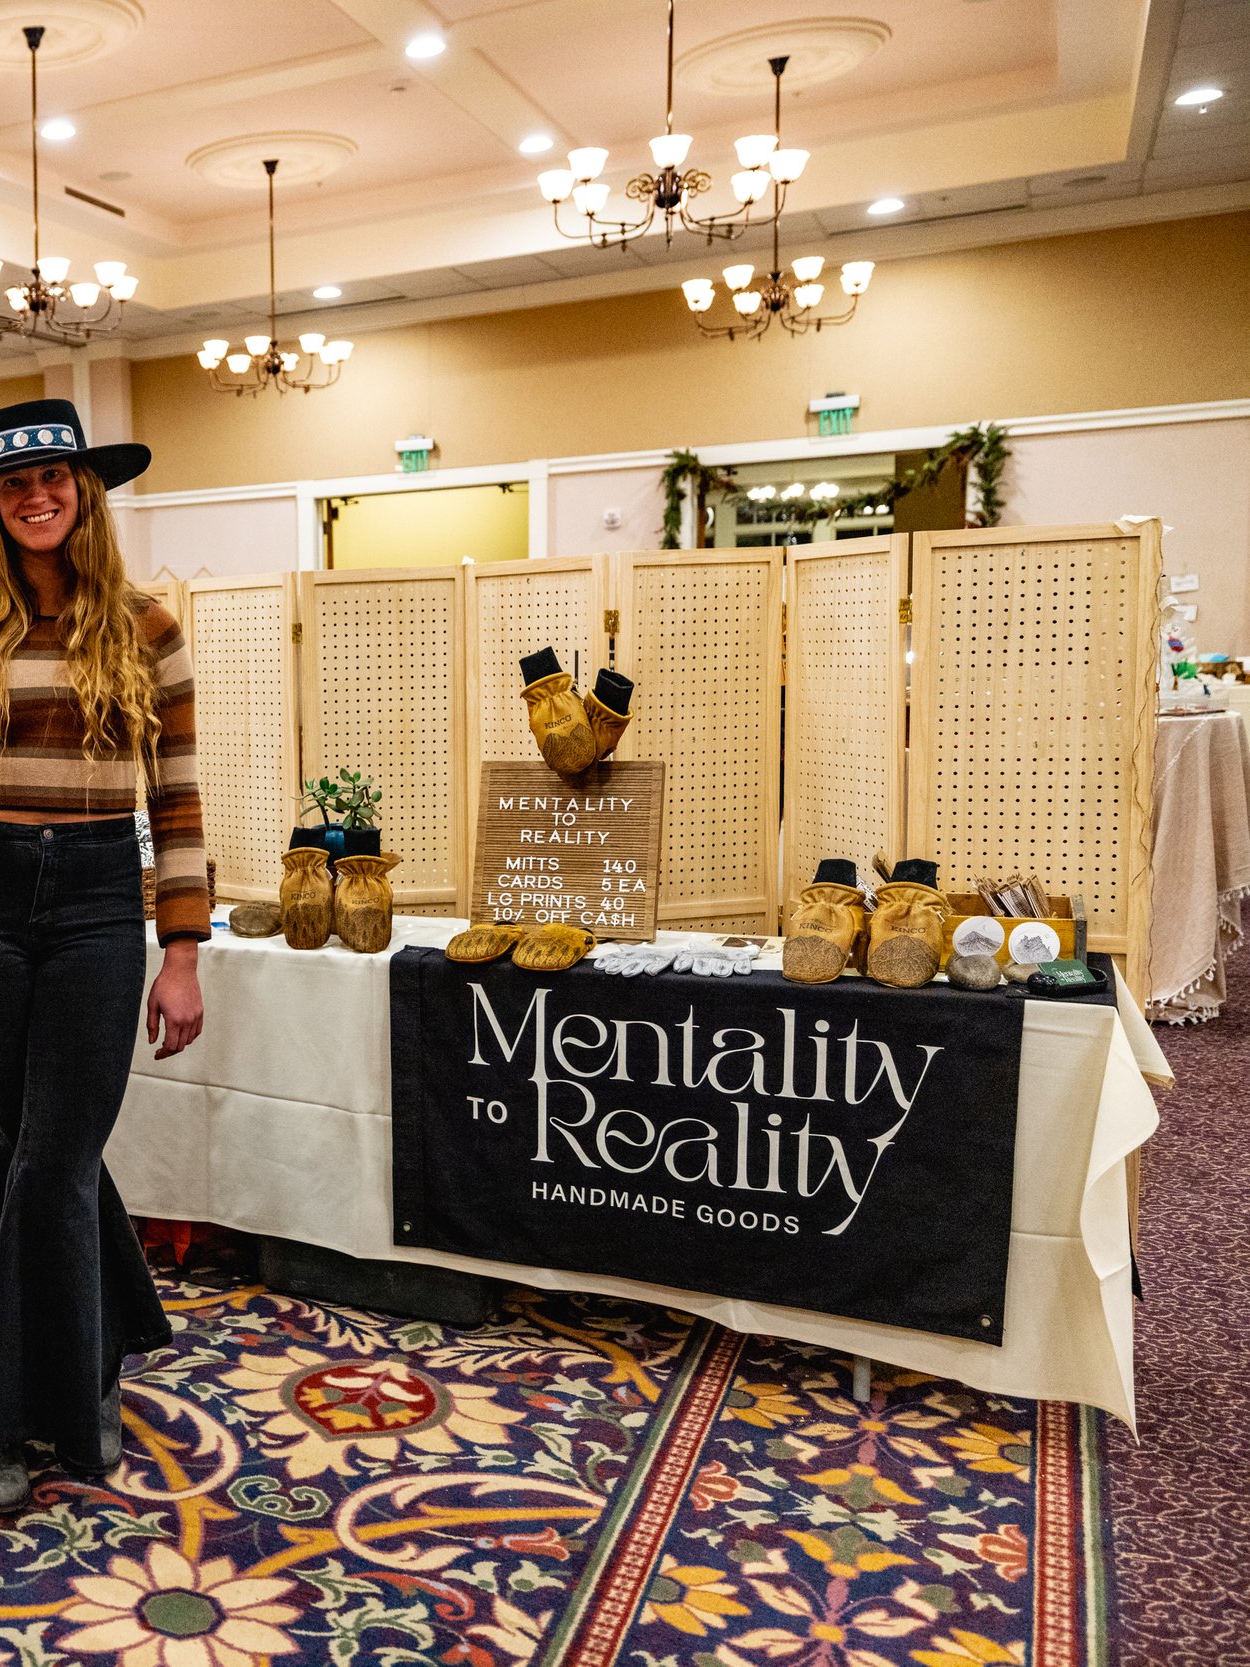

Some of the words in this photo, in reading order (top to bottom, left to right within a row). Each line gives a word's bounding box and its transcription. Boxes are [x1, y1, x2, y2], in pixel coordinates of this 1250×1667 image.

[818, 407, 853, 436] EXIT
[544, 714, 572, 730] KINCO
[499, 797, 633, 812] MENTALITY
[552, 812, 576, 826] TO
[520, 829, 610, 845] REALITY
[506, 856, 560, 871] MITTS
[602, 859, 637, 874] 140
[497, 873, 564, 890] CARDS
[601, 877, 613, 892] 5
[618, 878, 647, 893] EA
[290, 889, 317, 901] KINCO
[351, 896, 380, 906] KINCO
[487, 891, 514, 906] LG
[520, 892, 587, 910] PRINTS
[599, 896, 625, 911] 40
[535, 908, 572, 924] OFF
[580, 911, 636, 928] CA$H
[799, 921, 834, 934] KINCO
[889, 923, 927, 935] KINCO
[466, 981, 945, 1143] Mentality
[466, 1095, 508, 1125] TO
[528, 1078, 896, 1237] Reality
[531, 1180, 686, 1219] HANDMADE
[696, 1203, 801, 1235] GOODS
